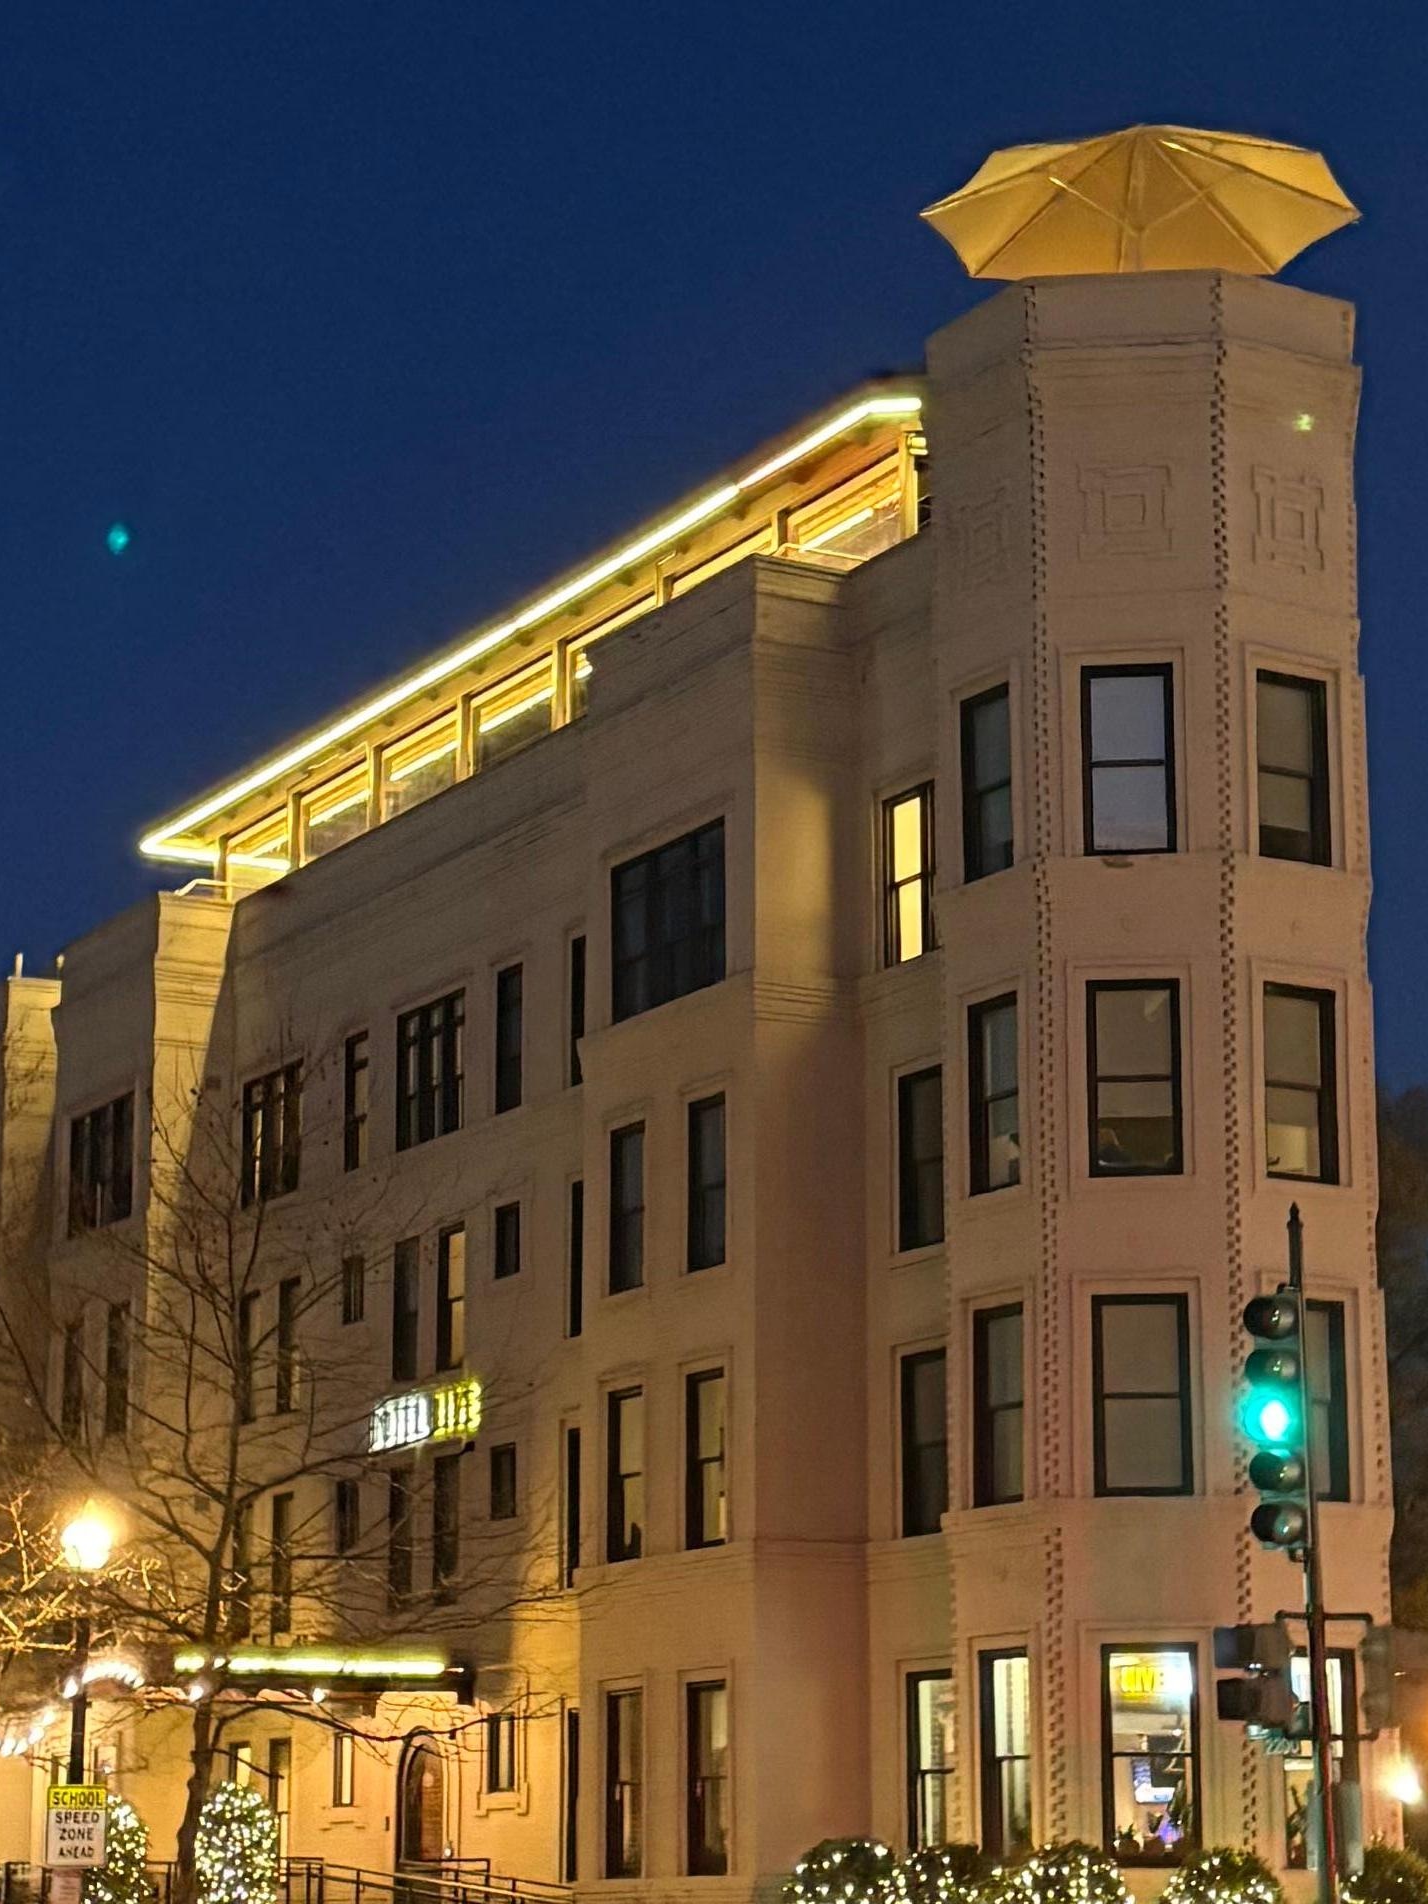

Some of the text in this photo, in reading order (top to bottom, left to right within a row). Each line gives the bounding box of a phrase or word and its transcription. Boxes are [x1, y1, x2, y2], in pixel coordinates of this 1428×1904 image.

[52, 1791, 103, 1806] SCHOOL
[55, 1811, 100, 1824] SPEED
[59, 1827, 94, 1841] ZONE
[58, 1846, 95, 1859] AHEAD
